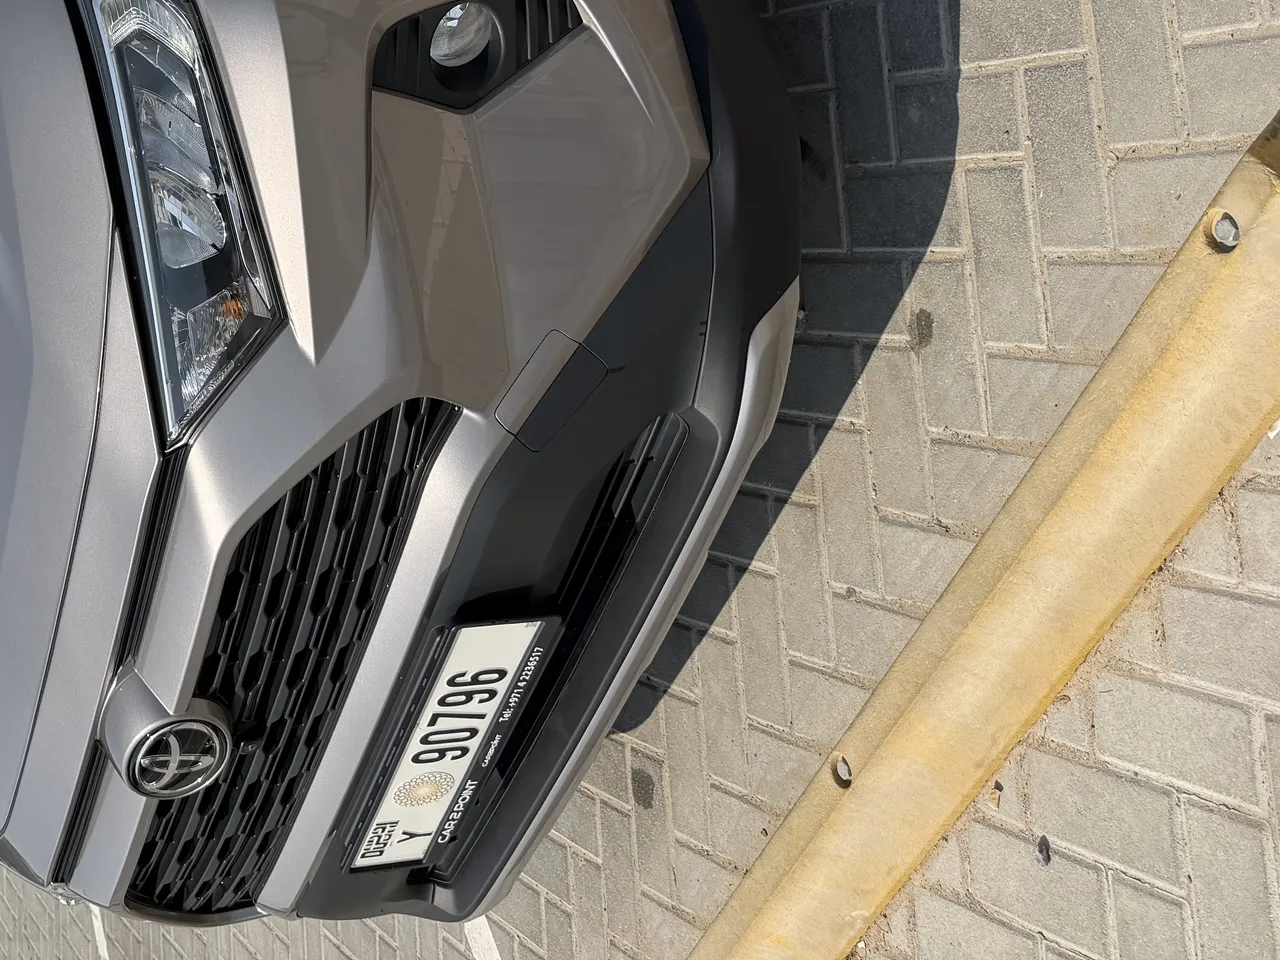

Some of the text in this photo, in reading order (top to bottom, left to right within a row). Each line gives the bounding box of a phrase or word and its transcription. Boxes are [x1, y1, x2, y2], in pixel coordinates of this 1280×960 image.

[410, 668, 508, 764] 90796
[498, 708, 514, 722] Tel:
[508, 688, 524, 707] +971
[520, 646, 544, 680] 2236517
[396, 830, 434, 844] Y
[438, 820, 458, 844] CAR
[454, 780, 478, 811] POINT
